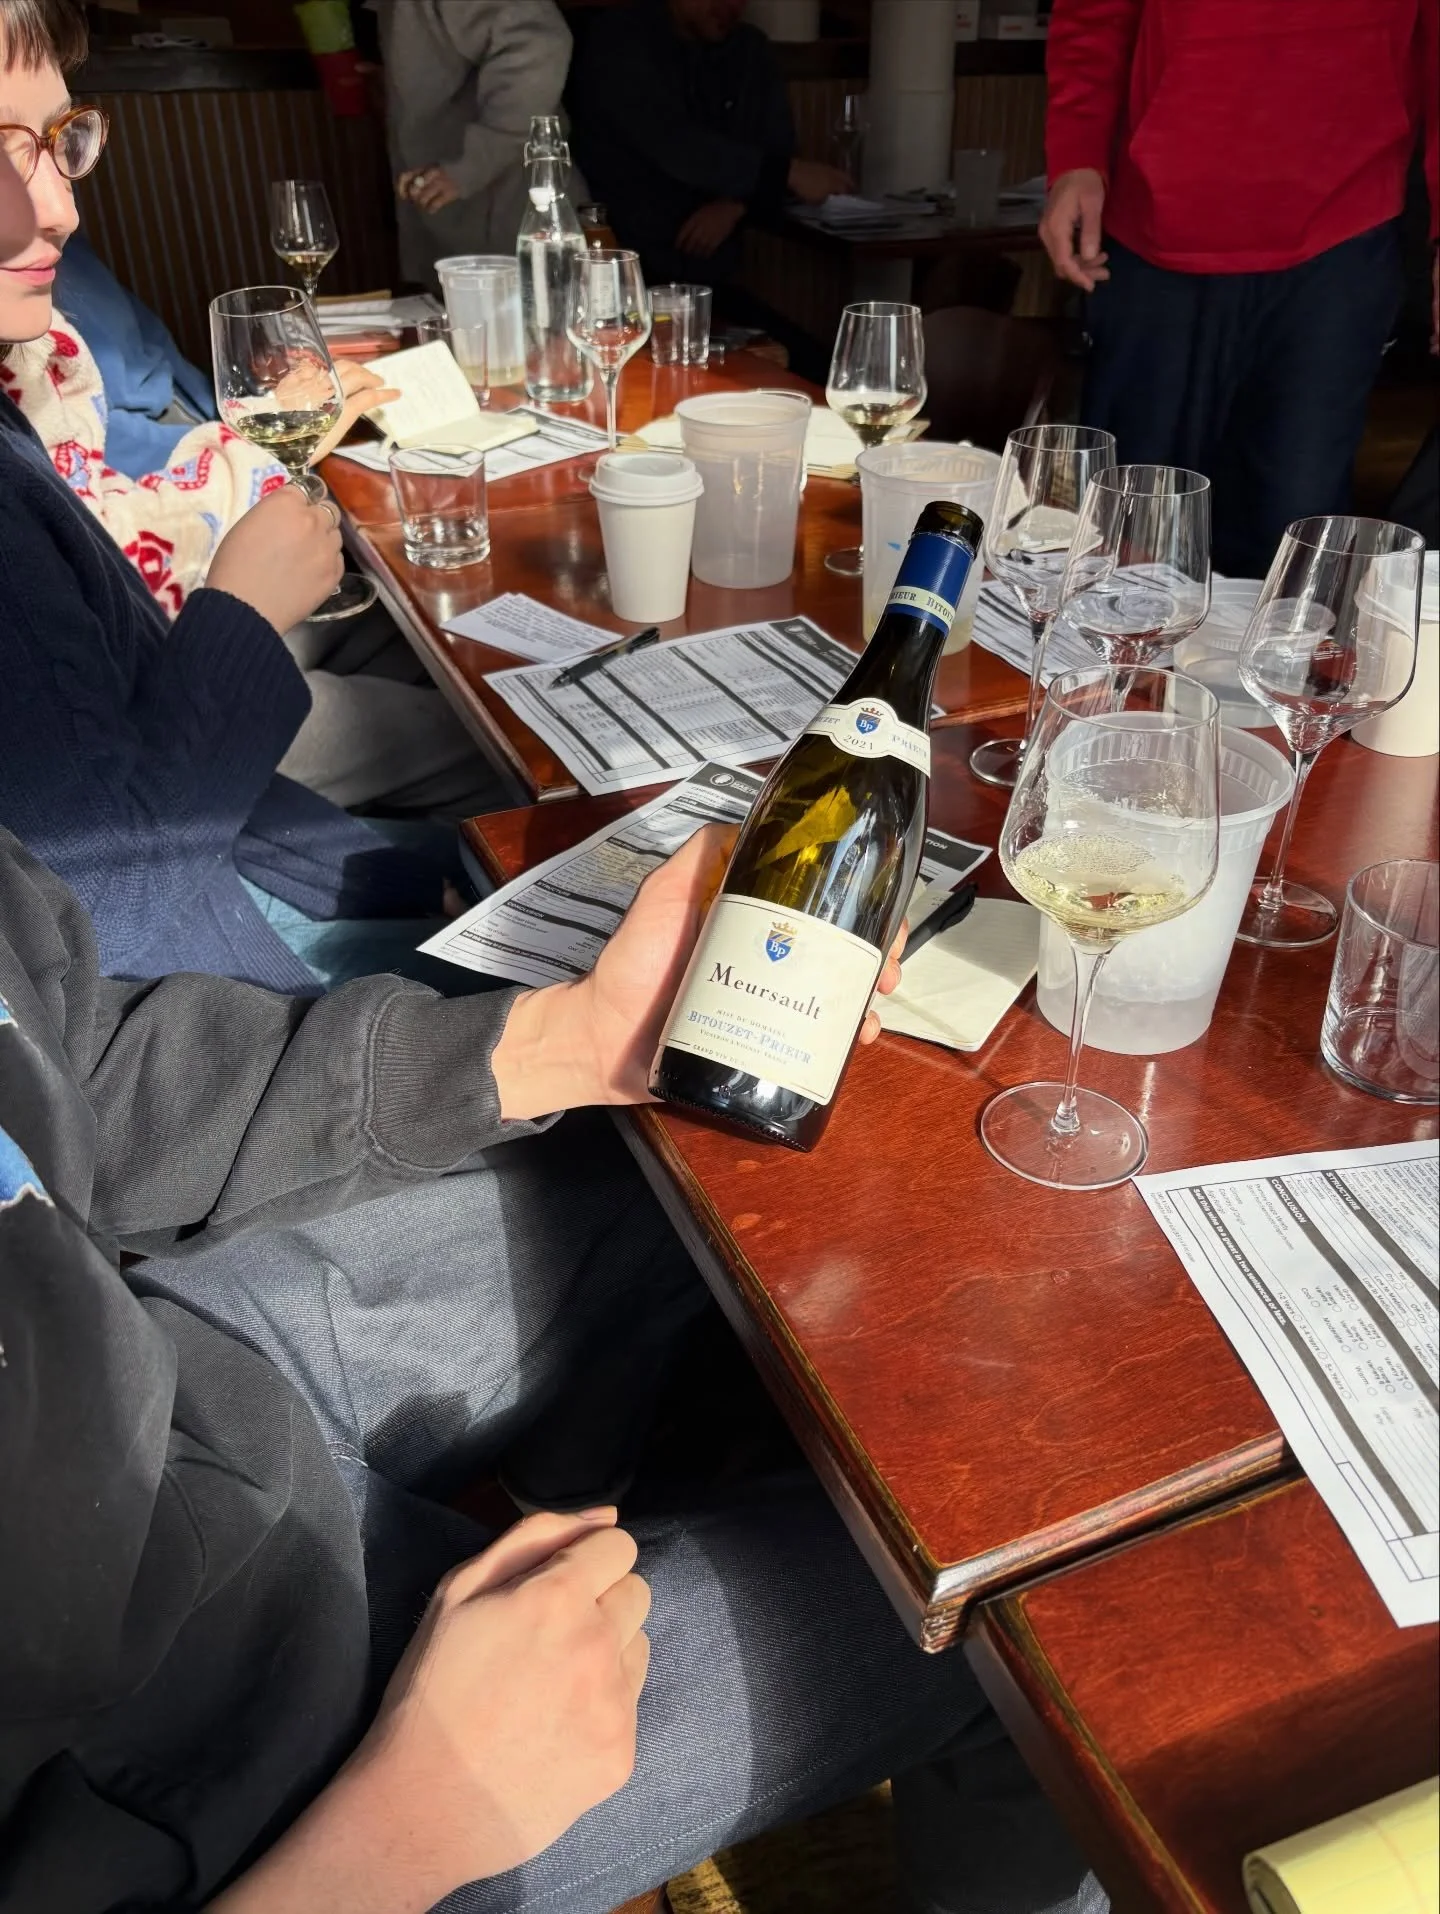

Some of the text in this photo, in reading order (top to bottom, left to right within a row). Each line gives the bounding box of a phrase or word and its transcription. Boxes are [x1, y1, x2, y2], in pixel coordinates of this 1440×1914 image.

[843, 735, 874, 751] 2021
[707, 962, 822, 1020] Meursault
[1272, 1179, 1306, 1222] CONCLUSION
[1326, 1172, 1360, 1209] STRUCTURE
[1193, 1189, 1204, 1199] Sell
[1200, 1200, 1210, 1211] this
[1207, 1212, 1219, 1225] wine
[1222, 1237, 1238, 1253] guest
[1239, 1260, 1249, 1272] two
[1247, 1273, 1271, 1302] sentences
[1323, 1317, 1343, 1343] Moderate
